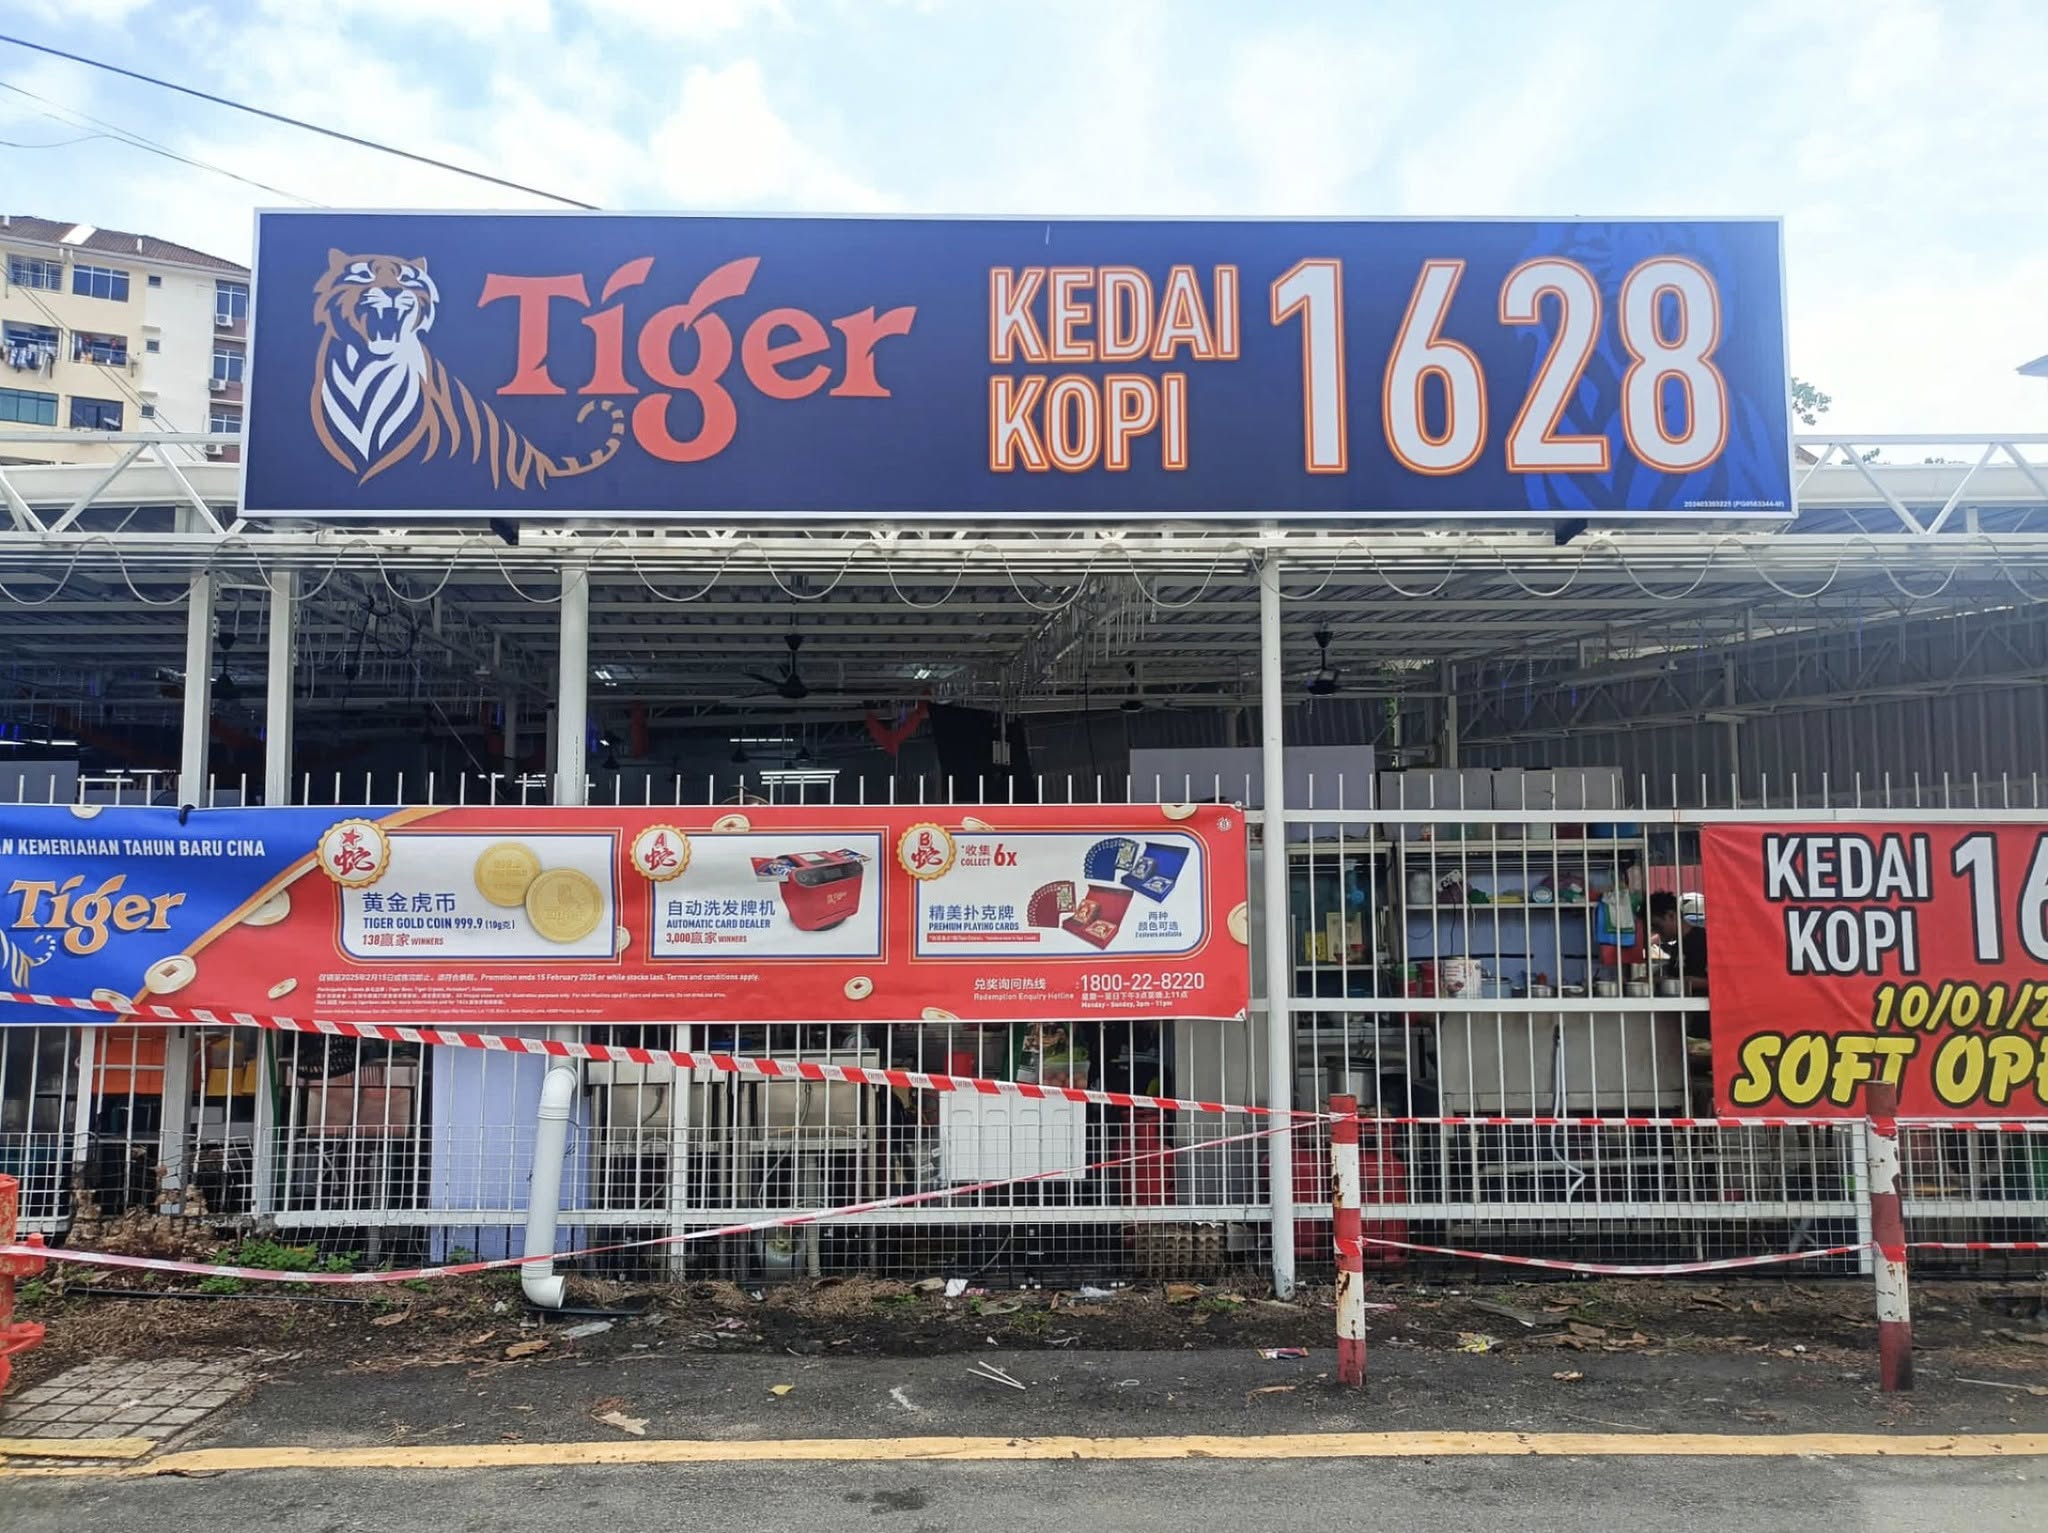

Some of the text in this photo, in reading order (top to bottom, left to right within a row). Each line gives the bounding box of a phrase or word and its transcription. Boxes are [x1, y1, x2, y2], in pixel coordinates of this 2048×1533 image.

[988, 264, 1240, 363] KEDAI
[478, 257, 917, 463] Tiger
[1270, 256, 1729, 474] 1628
[988, 373, 1188, 473] KOPI
[18, 838, 120, 856] KEMERIAHAN
[123, 839, 175, 857] TAHUN
[179, 839, 223, 857] BARU
[226, 840, 266, 857] CINA
[961, 843, 1017, 867] COLLECT 6x
[1765, 835, 1930, 900] KEDAI
[362, 891, 456, 914] 黄金虎币
[668, 899, 776, 916] 自动洗发牌机
[929, 904, 1015, 921] 精美扑克牌
[8, 874, 186, 955] Tiger
[363, 917, 394, 929] TIGER
[396, 917, 424, 929] GOLD
[426, 917, 451, 929] COIN
[454, 917, 483, 929] 999.9
[666, 919, 771, 929] AUTOMATIC CARD DEALER
[929, 922, 1019, 931] PREMIUM PLAYING CARDS
[411, 937, 444, 945] WINNERS
[1786, 908, 1917, 973] KOPI
[480, 973, 517, 981] Promotion
[546, 973, 578, 982] February
[1080, 972, 1205, 991] 1800-22-8220
[974, 991, 1075, 1001] Redemption Enquiry Hotline
[1733, 1034, 2048, 1104] SOFT OP
